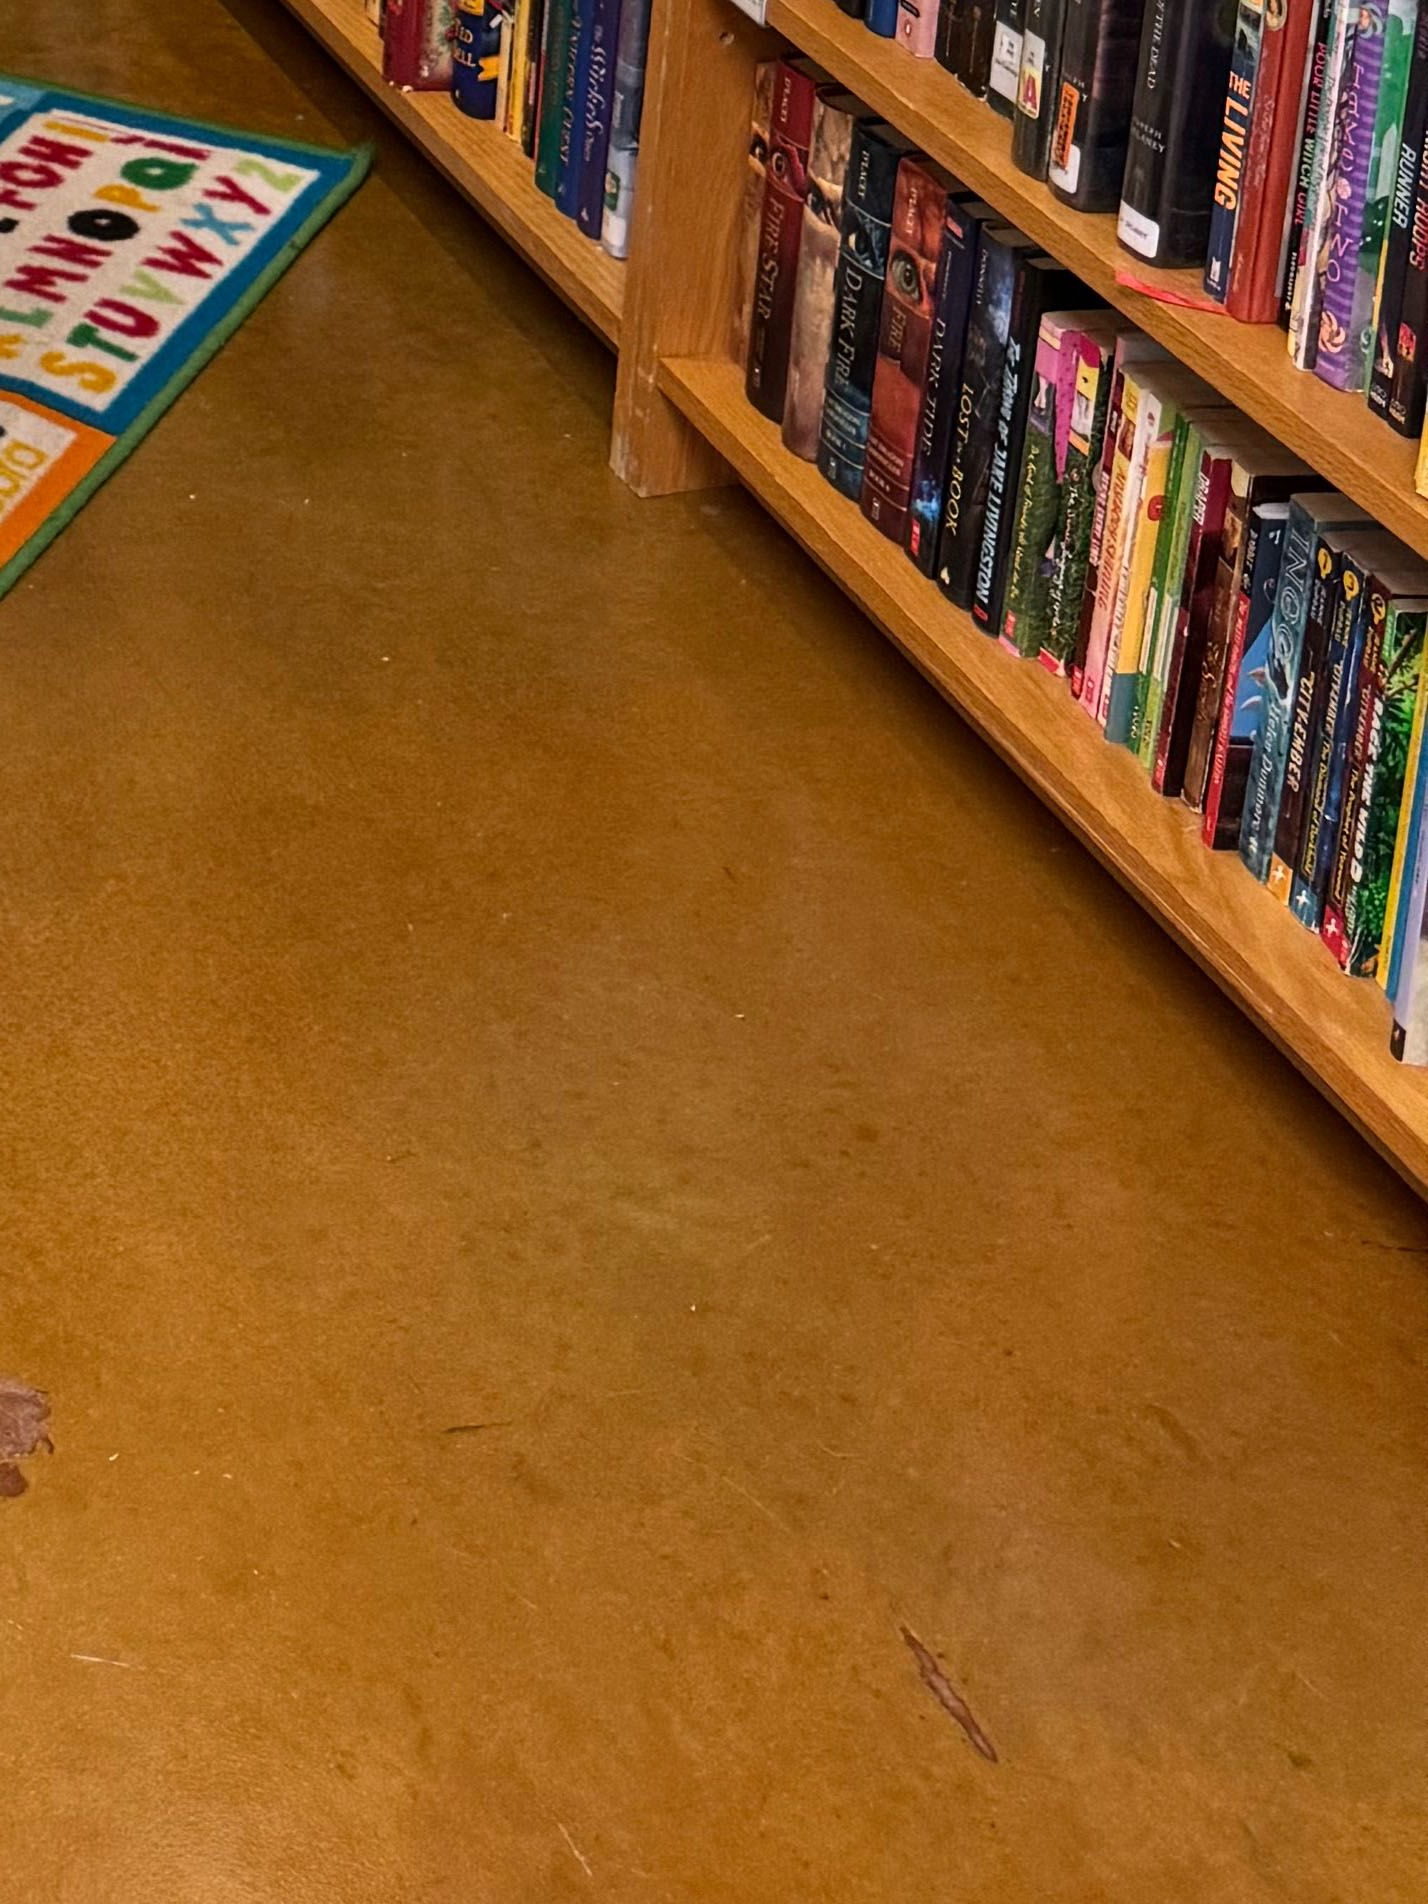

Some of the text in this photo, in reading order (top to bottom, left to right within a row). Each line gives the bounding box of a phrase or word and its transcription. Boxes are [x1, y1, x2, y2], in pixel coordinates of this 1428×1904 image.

[1214, 71, 1251, 210] THE LIVING
[1393, 143, 1417, 230] RUNNER
[945, 383, 975, 536] LOST BOOK
[974, 492, 1001, 609] LIVINGSTON
